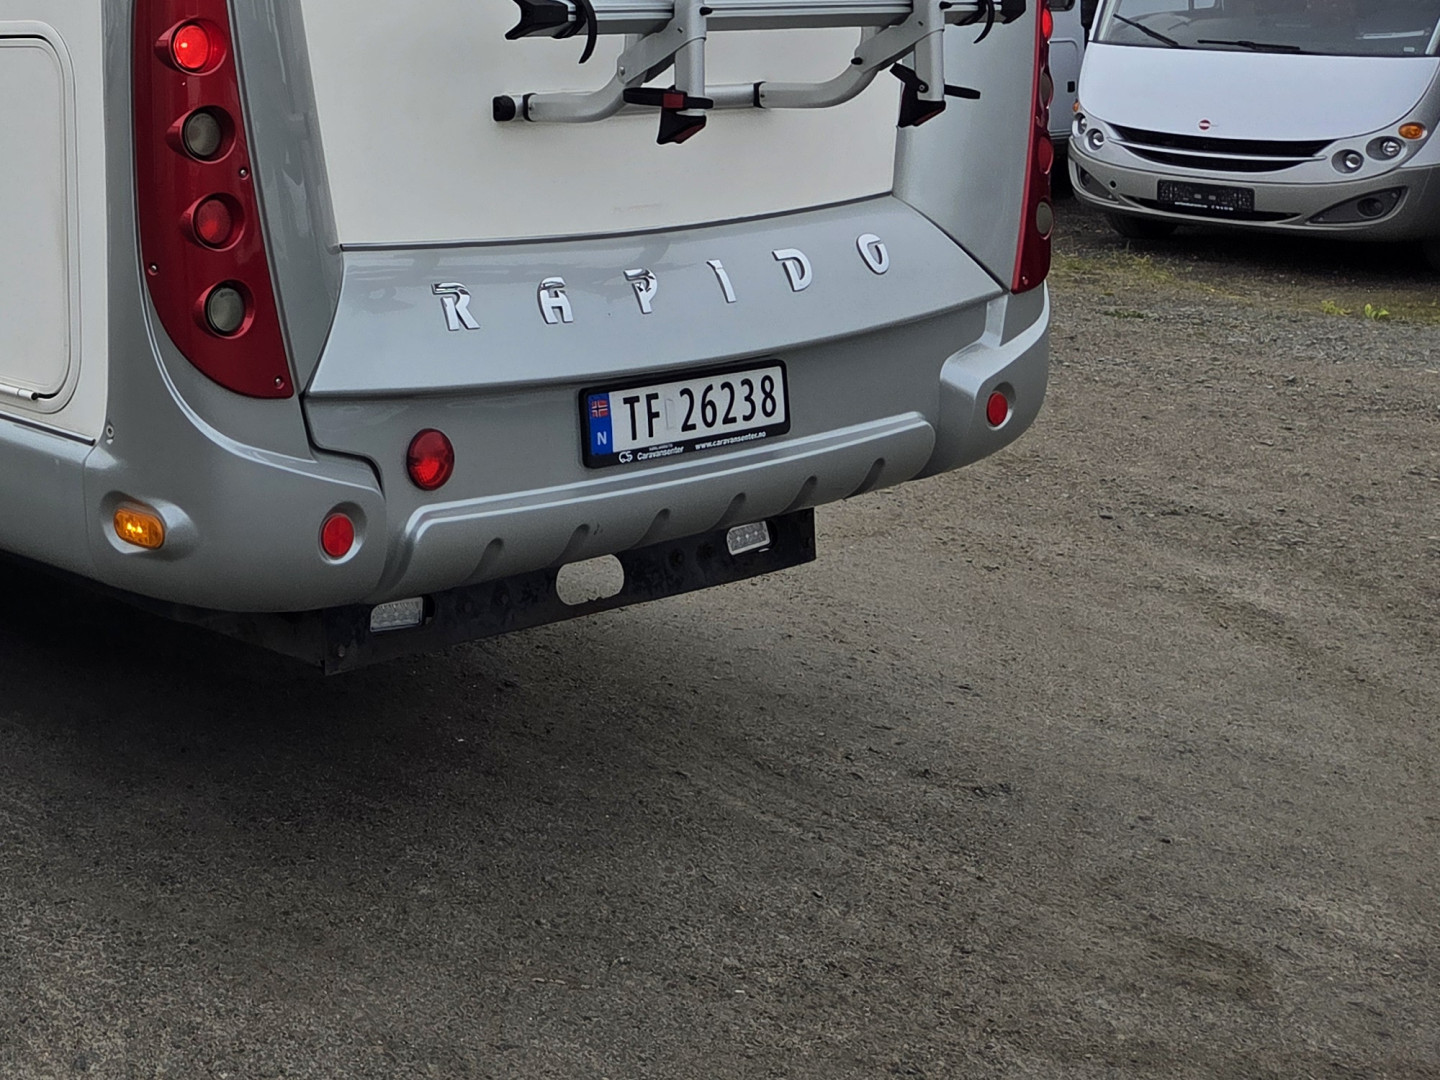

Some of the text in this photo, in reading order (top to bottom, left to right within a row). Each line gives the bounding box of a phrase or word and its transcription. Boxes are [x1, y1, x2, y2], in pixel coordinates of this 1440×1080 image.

[622, 374, 777, 441] TF 26238
[596, 431, 607, 446] N
[694, 431, 767, 450] www.caravansenter.no
[636, 445, 685, 461] Caravansenter
